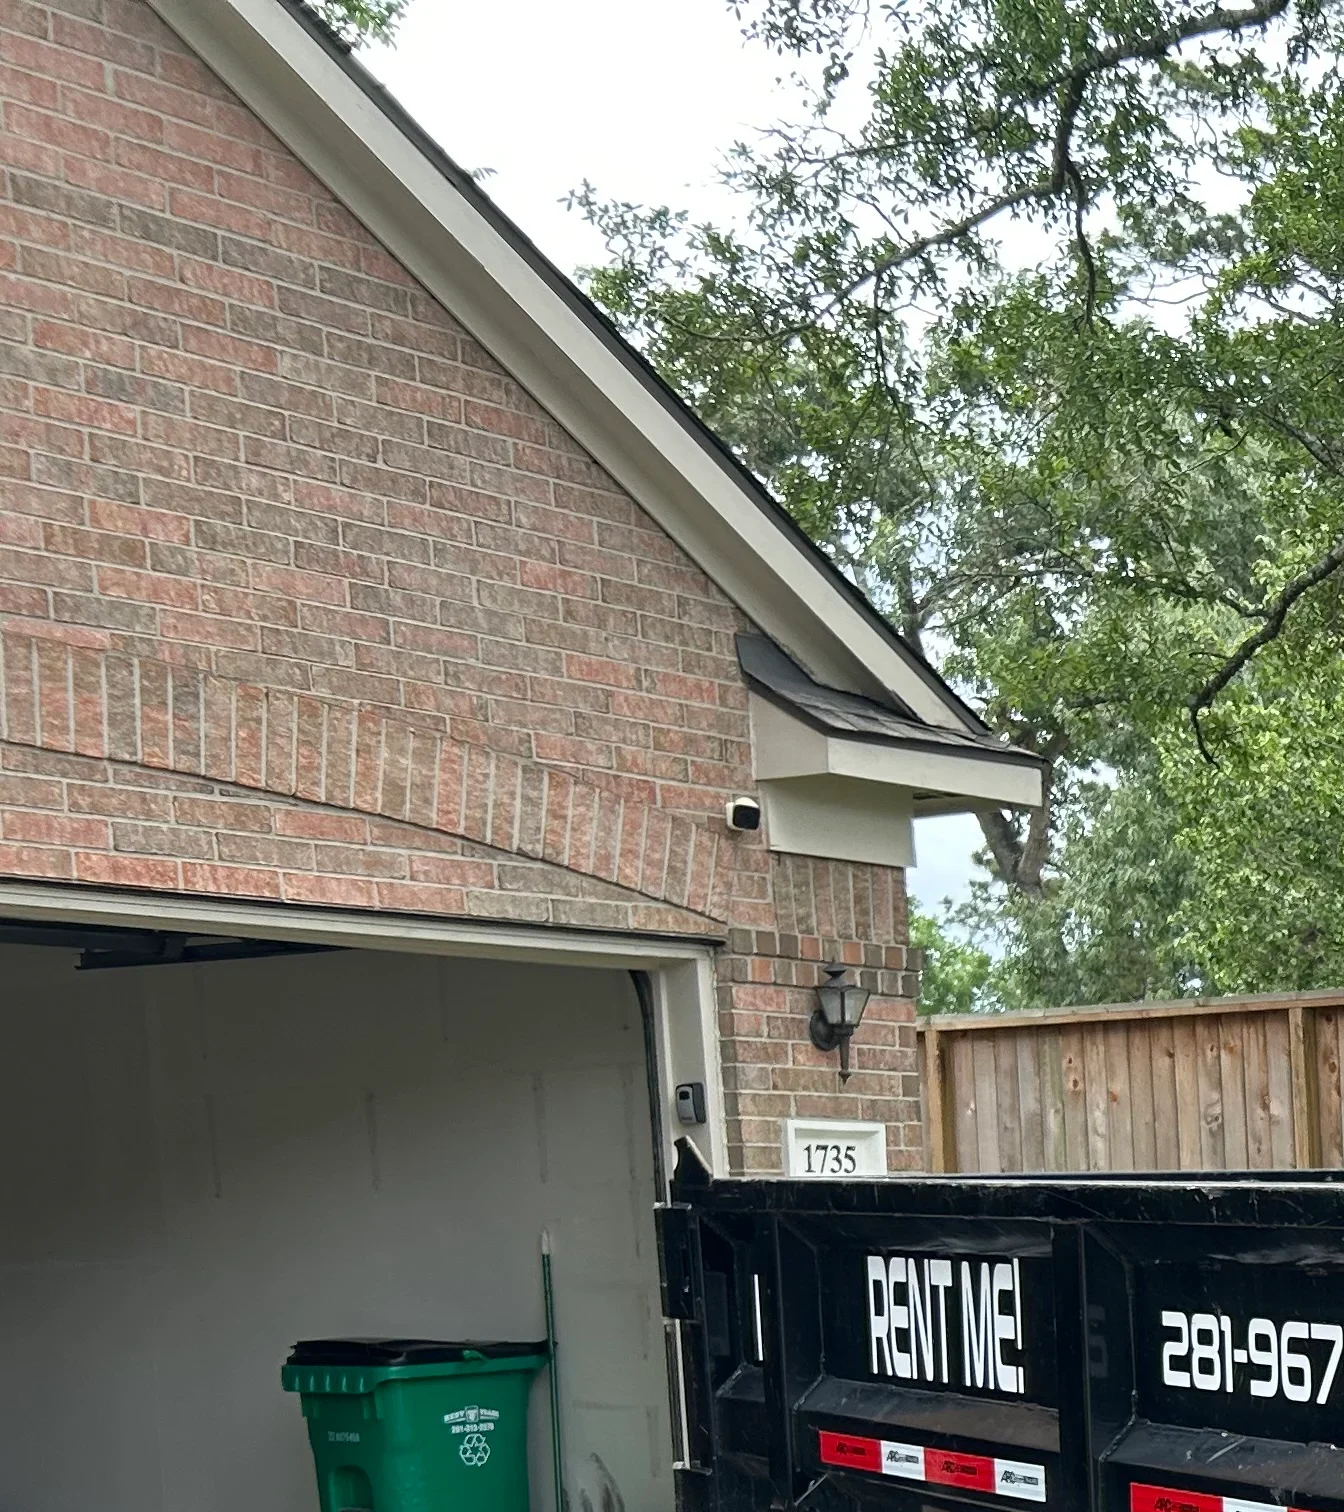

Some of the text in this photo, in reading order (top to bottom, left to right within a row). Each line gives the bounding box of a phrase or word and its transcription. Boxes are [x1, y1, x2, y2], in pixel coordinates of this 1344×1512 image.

[803, 1144, 857, 1173] 1735
[867, 1255, 1025, 1394] RENT ME!
